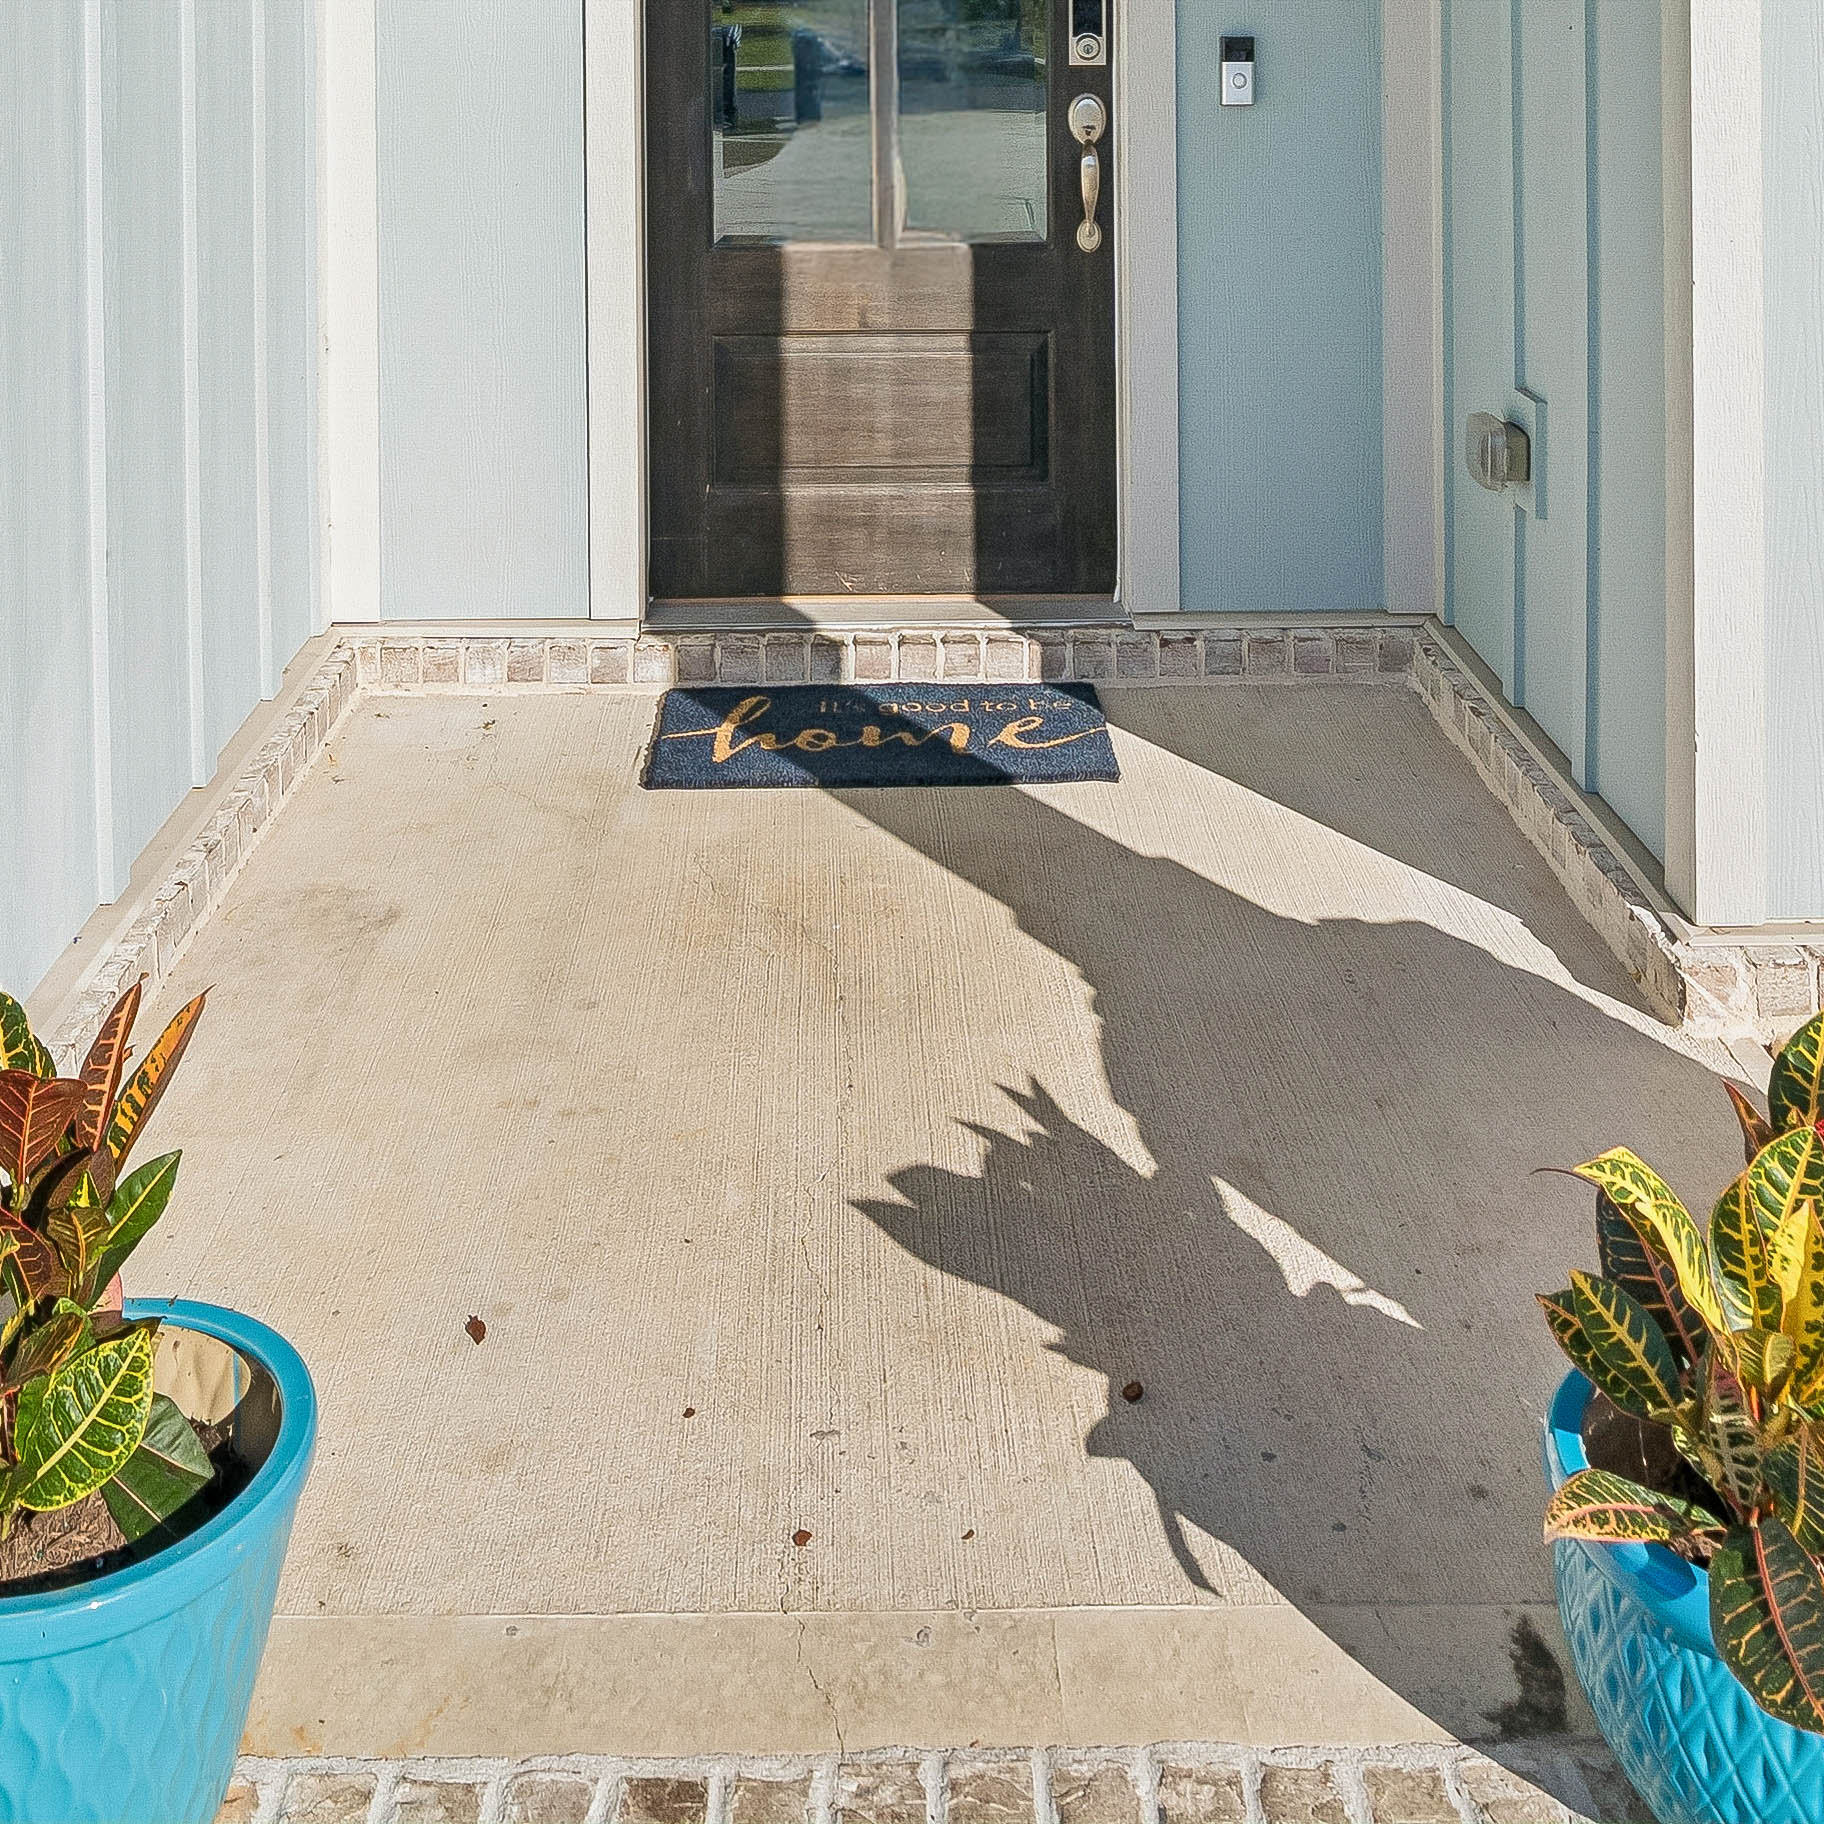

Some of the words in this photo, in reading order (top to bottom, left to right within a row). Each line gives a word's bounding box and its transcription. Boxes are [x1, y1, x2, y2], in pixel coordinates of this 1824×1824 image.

[879, 698, 970, 714] good
[980, 699, 1017, 713] to
[661, 695, 1108, 764] home
